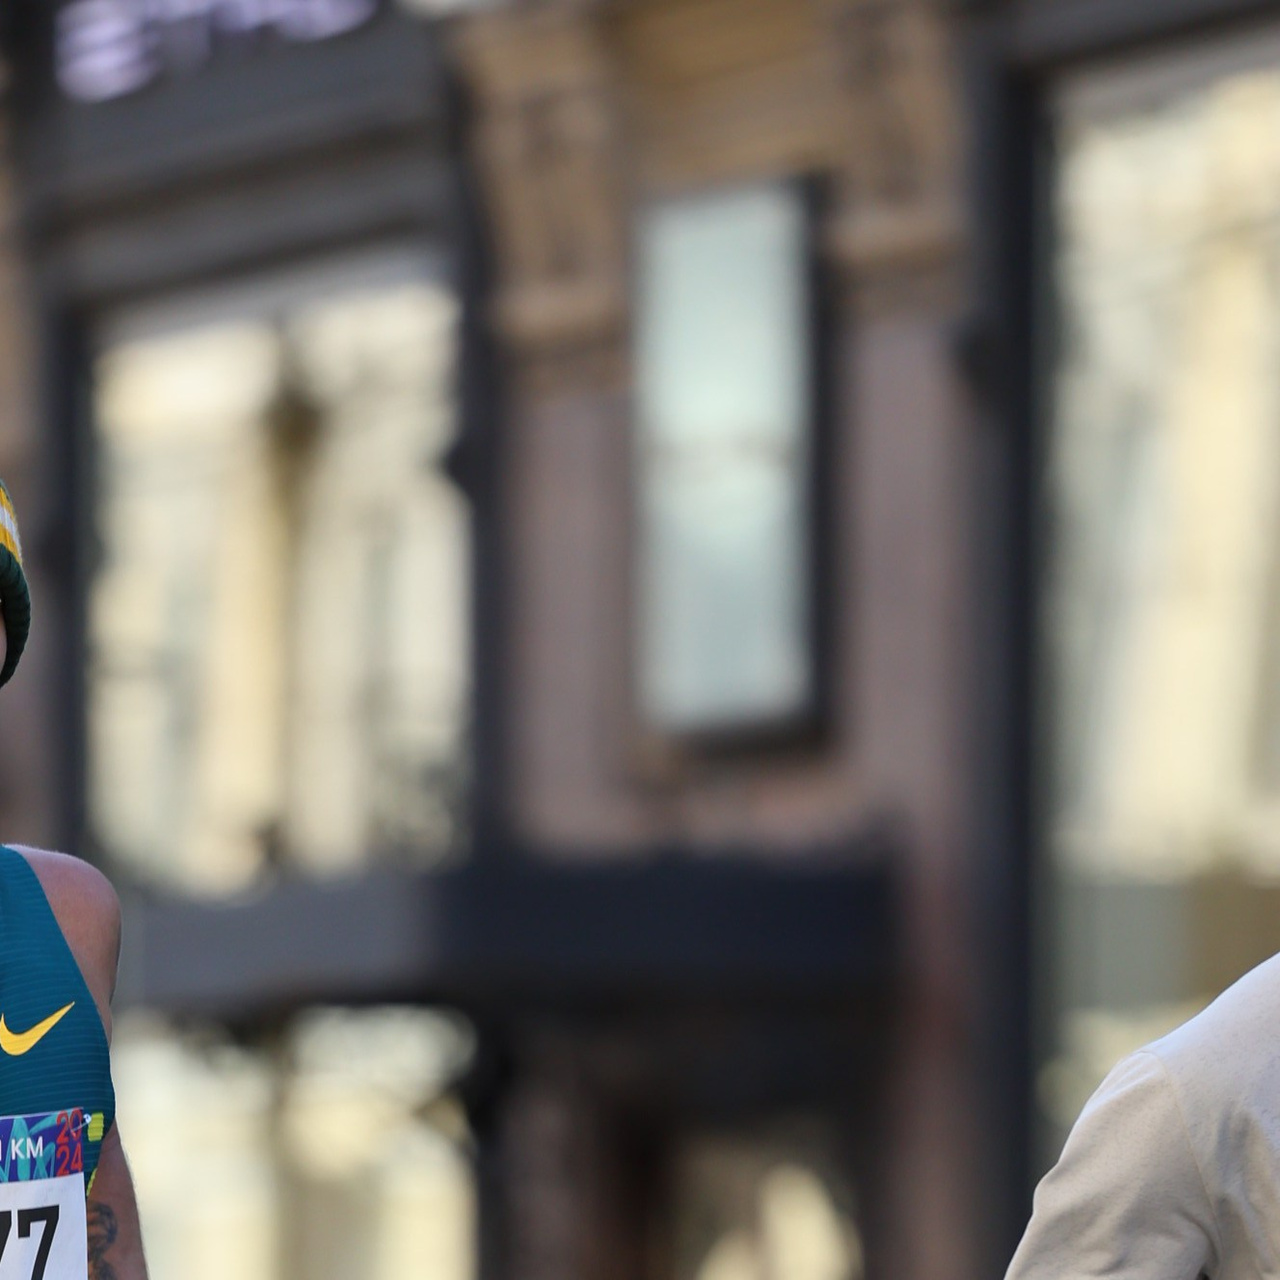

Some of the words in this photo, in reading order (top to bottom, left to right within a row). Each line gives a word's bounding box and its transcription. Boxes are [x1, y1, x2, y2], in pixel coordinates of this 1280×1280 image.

[56, 1107, 83, 1144] 20
[11, 1135, 43, 1160] КМ
[56, 1142, 84, 1177] 24
